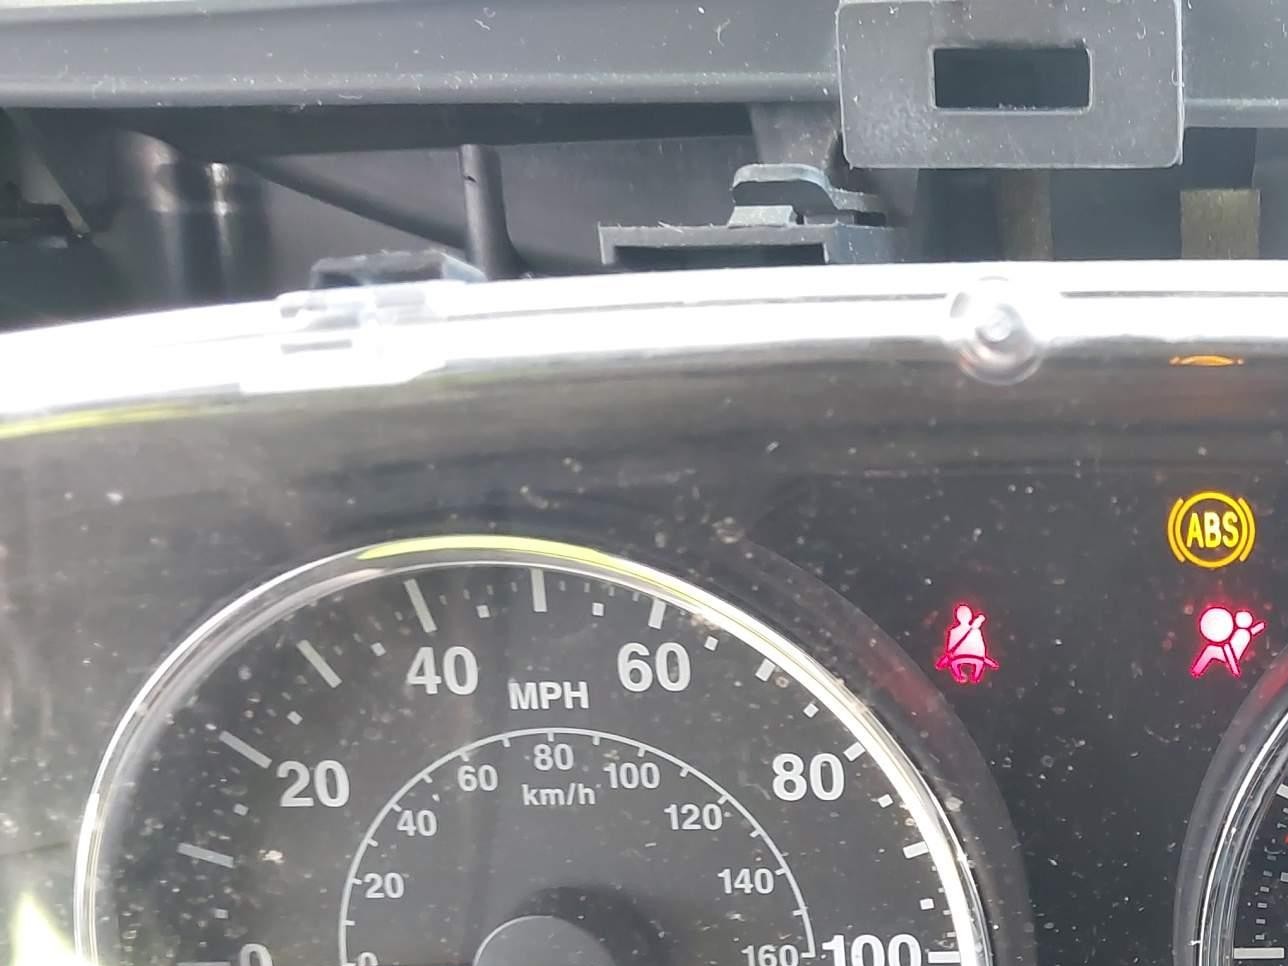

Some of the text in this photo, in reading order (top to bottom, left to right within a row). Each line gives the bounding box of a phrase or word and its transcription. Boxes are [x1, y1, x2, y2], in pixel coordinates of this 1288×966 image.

[1186, 512, 1239, 548] ABS
[406, 646, 479, 695] 40
[617, 642, 691, 691] 60
[508, 681, 589, 710] MPH
[534, 743, 574, 772] 80
[276, 760, 350, 808] 20
[457, 764, 498, 792] 60
[604, 763, 661, 790] 100
[772, 753, 845, 801] 80
[522, 784, 597, 806] km/h
[397, 810, 438, 837] 40
[664, 803, 724, 831] 120
[365, 872, 404, 899] 20
[717, 868, 775, 895] 140
